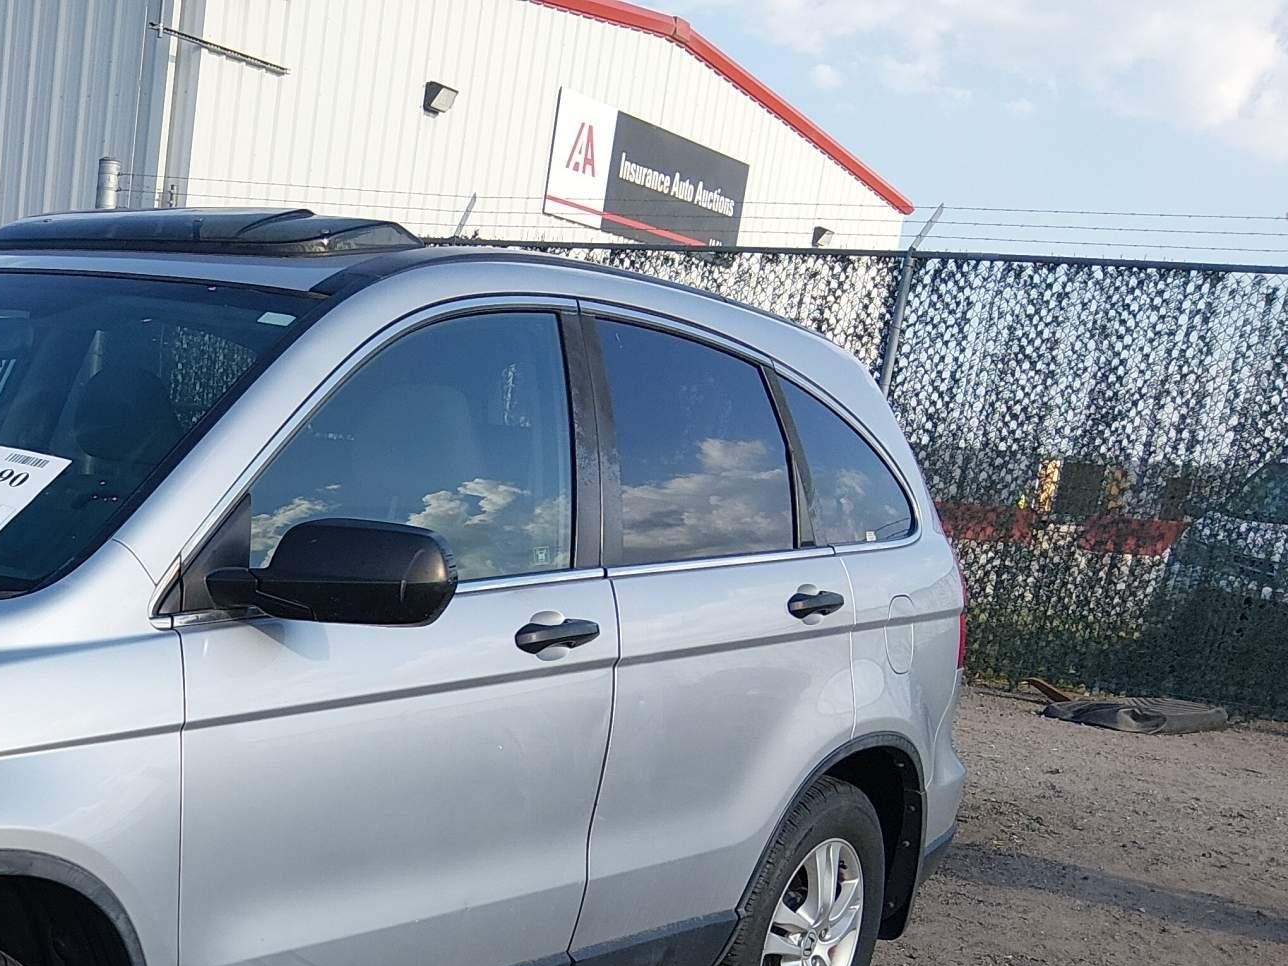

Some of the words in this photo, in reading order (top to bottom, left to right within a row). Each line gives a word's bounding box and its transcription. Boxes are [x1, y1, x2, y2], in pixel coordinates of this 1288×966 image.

[619, 152, 671, 194] Insurance
[670, 172, 694, 202] Auto
[694, 181, 734, 216] Auctions
